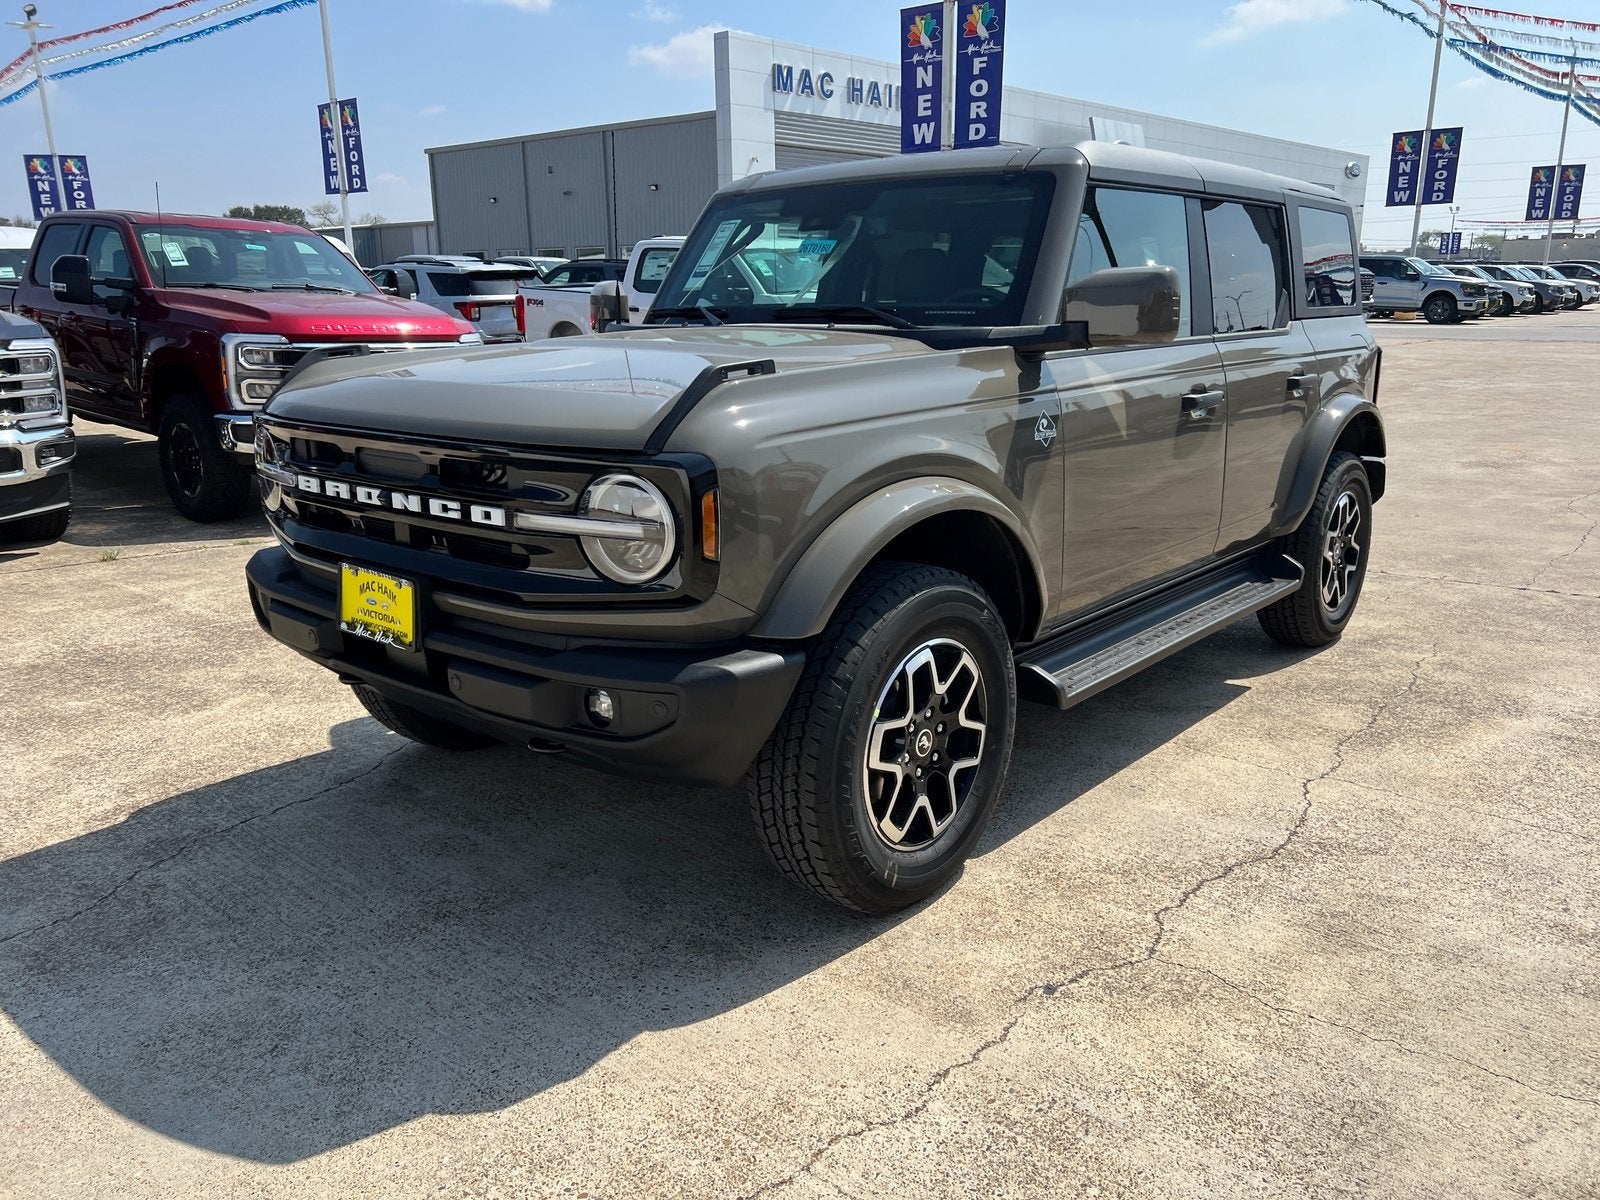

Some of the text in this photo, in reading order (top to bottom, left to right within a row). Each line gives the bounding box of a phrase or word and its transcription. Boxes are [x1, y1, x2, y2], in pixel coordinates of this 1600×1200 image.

[772, 63, 901, 111] MAC HAI
[912, 64, 936, 145] NEW
[968, 56, 989, 141] FORD
[327, 139, 341, 190] NEW
[348, 137, 361, 189] FORD
[1393, 160, 1411, 203] NEW
[1431, 158, 1448, 202] FORD
[36, 181, 55, 218] NEW
[72, 181, 87, 209] FOR
[1531, 188, 1546, 219] NEW
[1561, 186, 1574, 218] FORD
[526, 297, 544, 307] FX4
[297, 474, 507, 527] BRONCO
[359, 580, 398, 606] MAC HAIK
[353, 623, 374, 640] Mac
